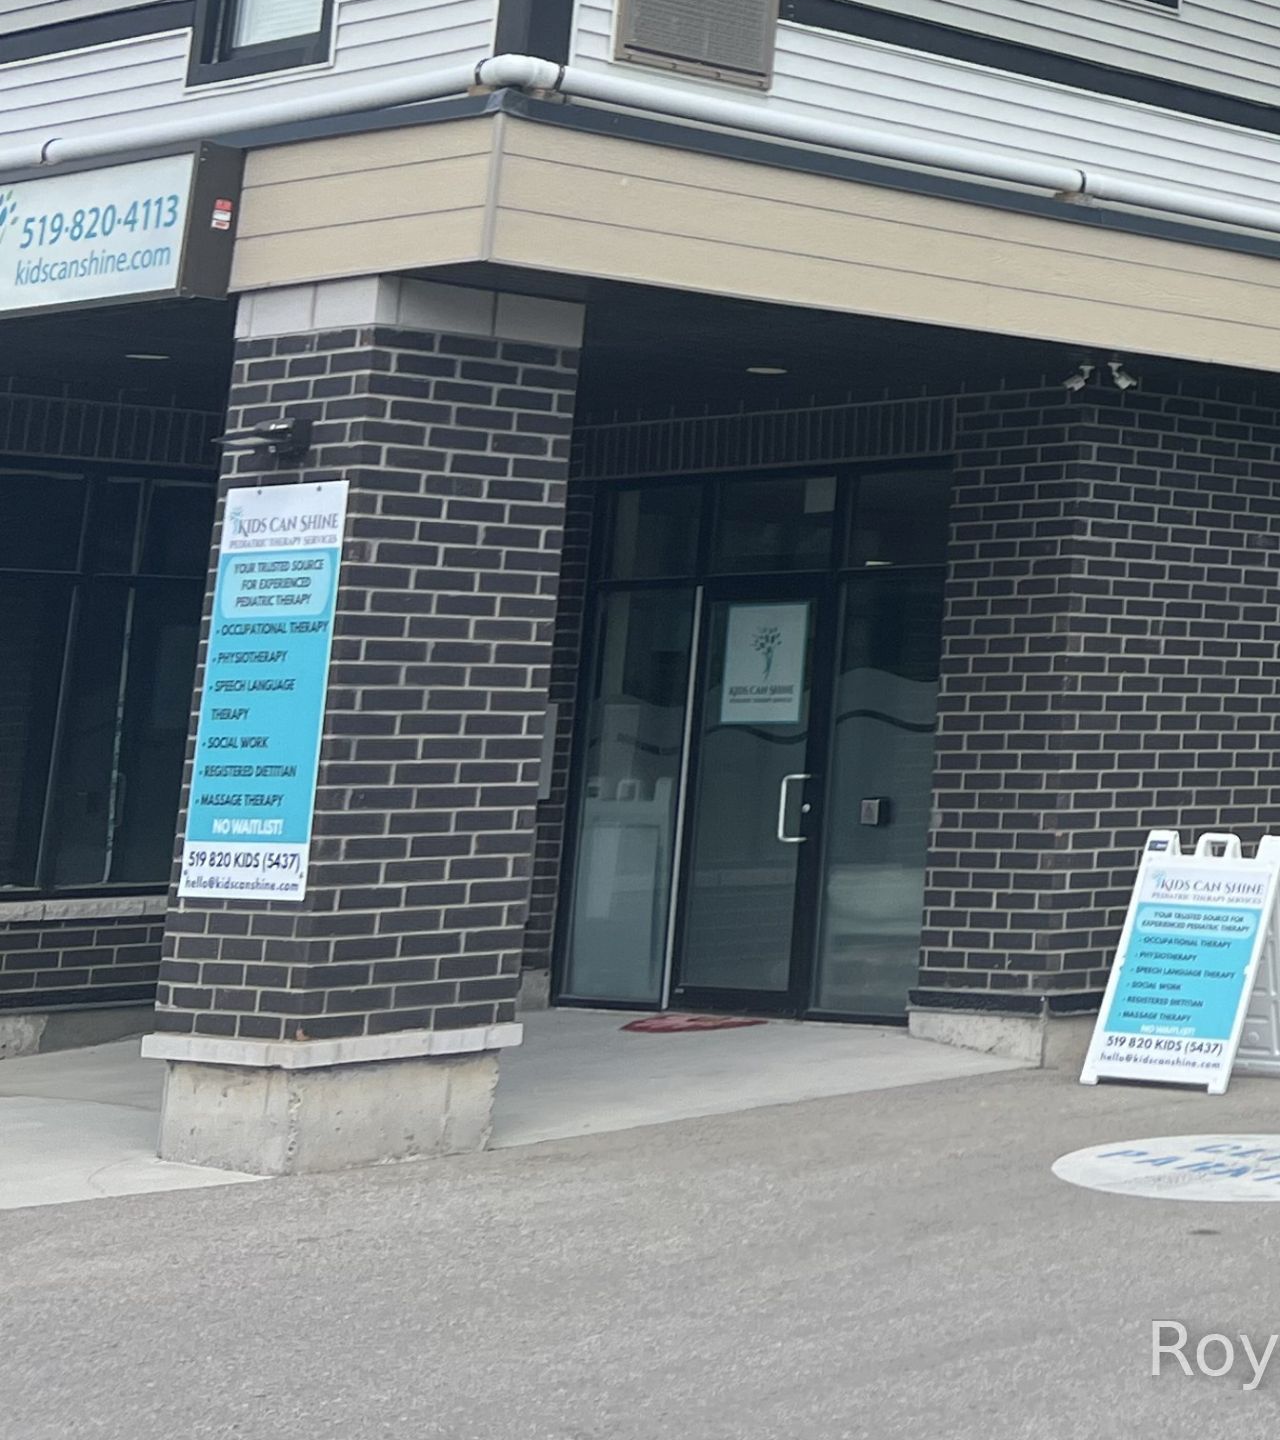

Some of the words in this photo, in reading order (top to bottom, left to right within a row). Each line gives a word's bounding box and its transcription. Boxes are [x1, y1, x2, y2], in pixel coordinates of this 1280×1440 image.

[14, 245, 171, 286] kidscanshine.com
[238, 517, 267, 537] KIDS
[269, 516, 298, 532] CAN
[299, 513, 339, 533] SHINE
[234, 562, 256, 574] YOUR
[257, 561, 290, 573] TRUSTED
[291, 559, 325, 571] SOURCE
[241, 579, 258, 590] FOR
[259, 577, 312, 590] EXPERIENCED
[235, 595, 275, 607] PEDIATRIC
[275, 594, 313, 606] THERAPY
[222, 622, 287, 636] OCCUPATIONAL
[289, 620, 329, 633] THERAPY
[217, 650, 288, 664] PHYSIOTHERAPY
[214, 680, 246, 692] SPEECH
[247, 679, 296, 692] LANGUAGE
[211, 708, 250, 721] THERAPY
[207, 736, 239, 749] SOCIAL
[240, 736, 270, 749] WORK
[203, 765, 254, 777] REGISTERED
[200, 793, 242, 806] MASSAGE
[243, 794, 285, 807] THERAPY
[212, 818, 230, 835] NO
[188, 851, 207, 867] 519
[208, 851, 232, 868] 820
[232, 852, 261, 868] KIDS
[262, 851, 301, 874] (5437)
[1160, 879, 1191, 893] KIDS
[1193, 880, 1221, 892] CAN
[1222, 882, 1265, 895] SHINE
[1143, 936, 1198, 947] OCCUPATIONAL
[1200, 938, 1232, 949] THERAPY
[1135, 965, 1163, 975] SPEECH
[1203, 969, 1236, 979] THERAPY
[1122, 1010, 1159, 1020] MASSAGE
[1160, 1013, 1192, 1022] THERAPY
[1106, 1035, 1127, 1047] 519
[1127, 1037, 1153, 1050] 820
[1154, 1039, 1183, 1052] KIDS
[1184, 1041, 1223, 1057] (5437)
